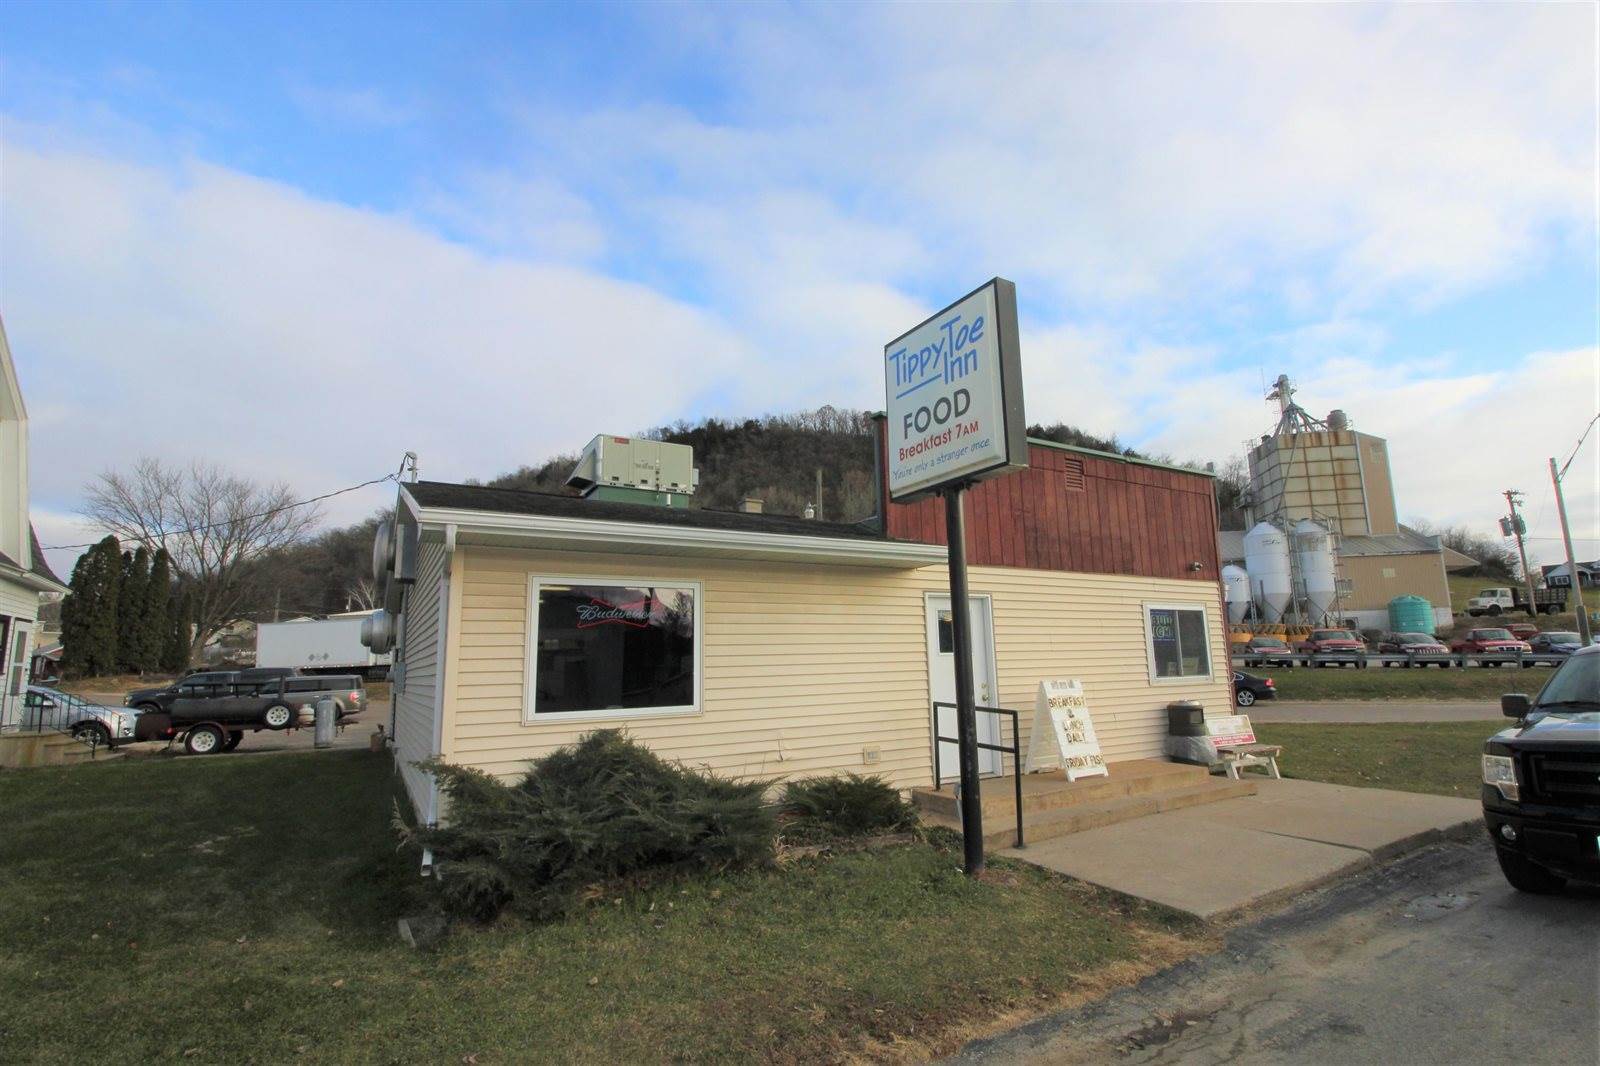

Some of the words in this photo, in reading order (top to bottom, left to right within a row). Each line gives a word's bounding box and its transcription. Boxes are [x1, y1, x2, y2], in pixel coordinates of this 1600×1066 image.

[889, 337, 945, 386] Tippy
[940, 314, 984, 354] Toe
[943, 349, 978, 384] Inn
[903, 388, 971, 439] FOOD
[899, 428, 952, 461] Breakfast
[936, 446, 969, 464] stranger
[970, 438, 990, 451] once
[1048, 696, 1086, 708] BREAKFAST
